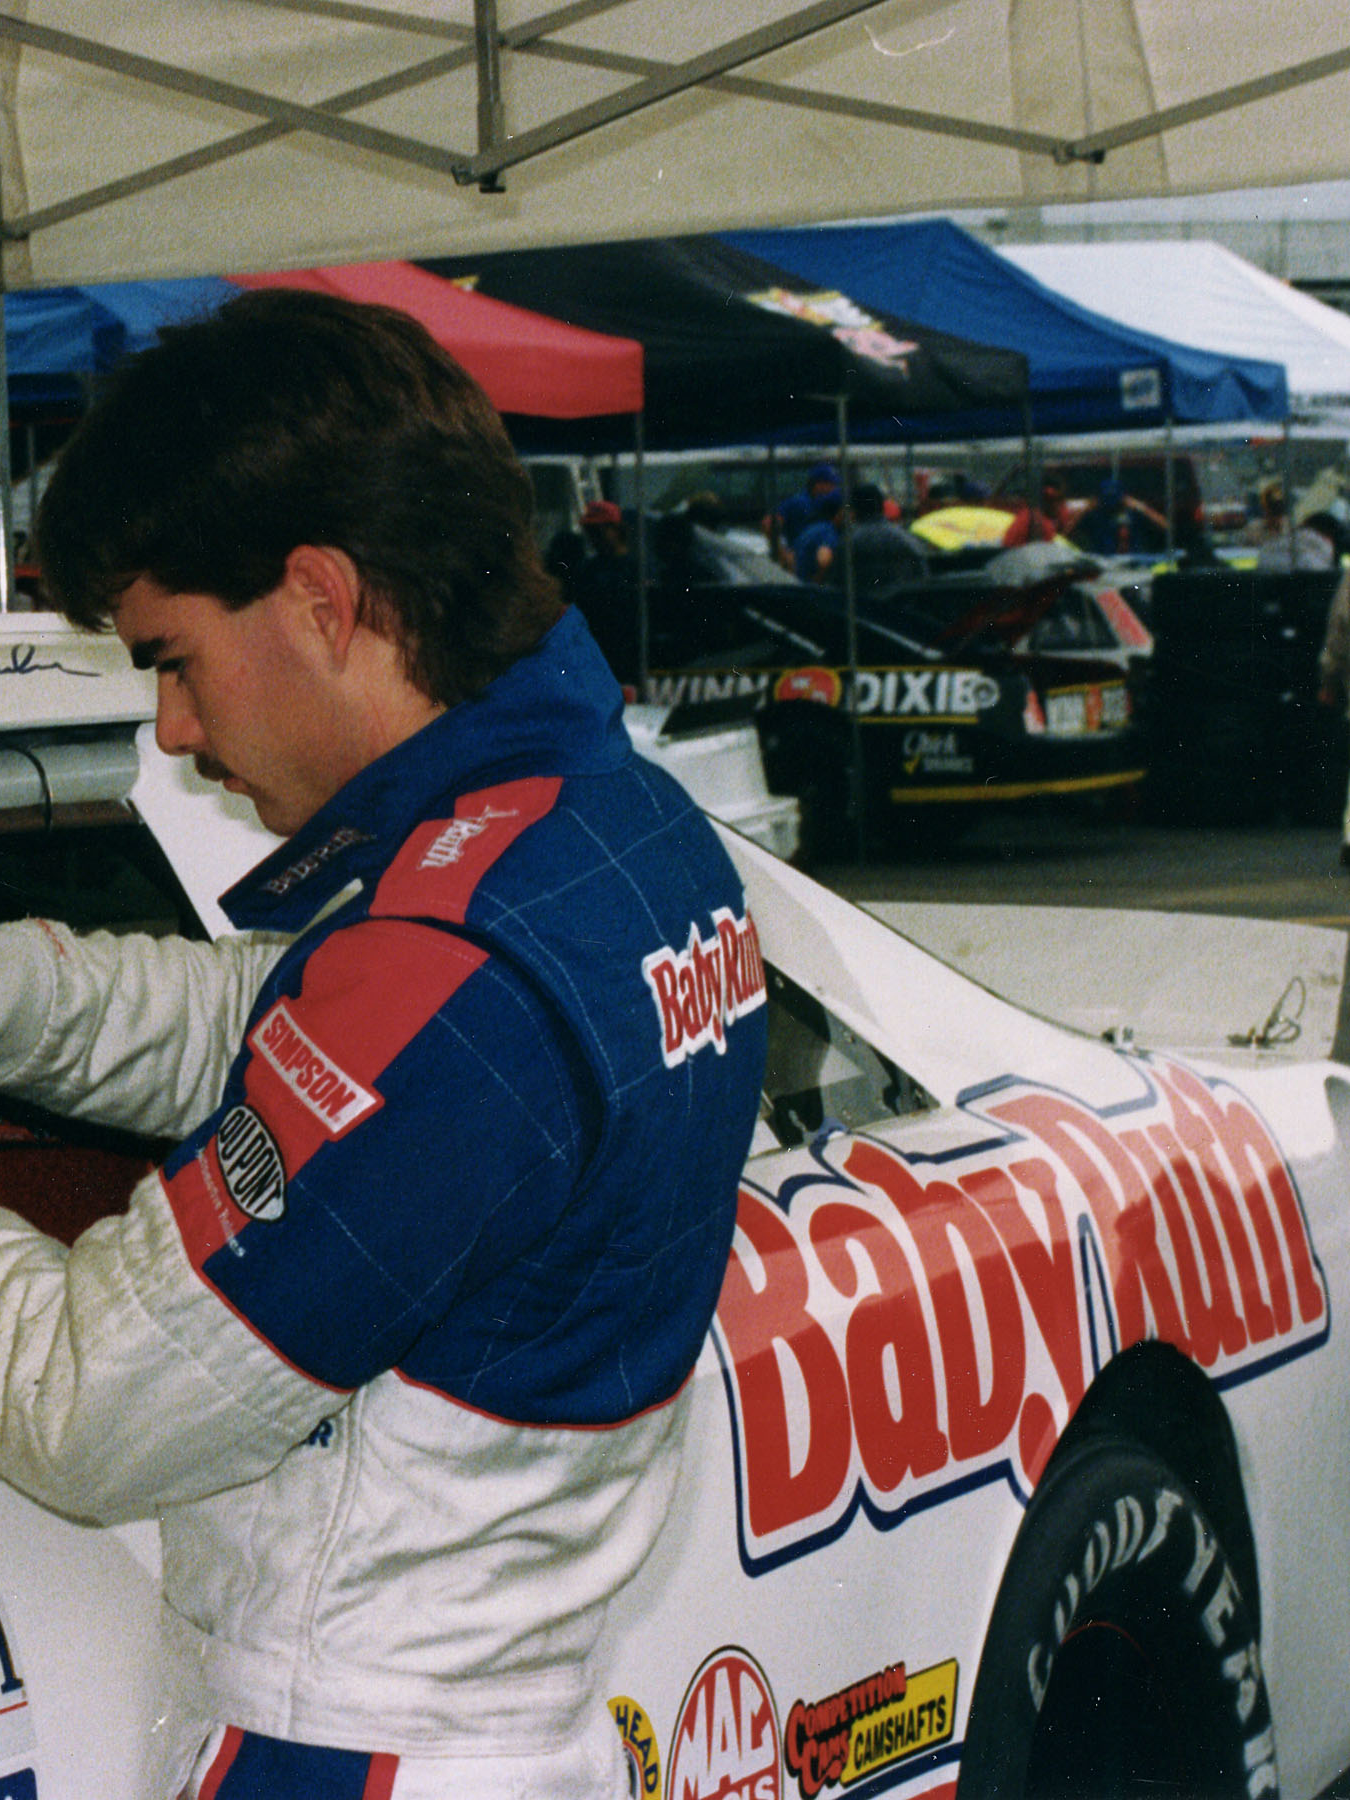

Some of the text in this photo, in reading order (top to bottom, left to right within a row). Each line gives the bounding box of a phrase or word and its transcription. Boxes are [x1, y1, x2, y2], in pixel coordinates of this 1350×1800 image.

[648, 675, 770, 708] WINN
[853, 672, 978, 714] DIXIE
[650, 938, 722, 1054] Baby
[261, 1012, 357, 1118] SIMPSON
[714, 1060, 1325, 1538] Baby Ruth
[613, 1703, 660, 1794] HEAD
[672, 1666, 776, 1800] MAC
[786, 1661, 907, 1770] COMPETITION
[801, 1729, 850, 1796] CAMS
[853, 1693, 947, 1771] CAMSHAFTS
